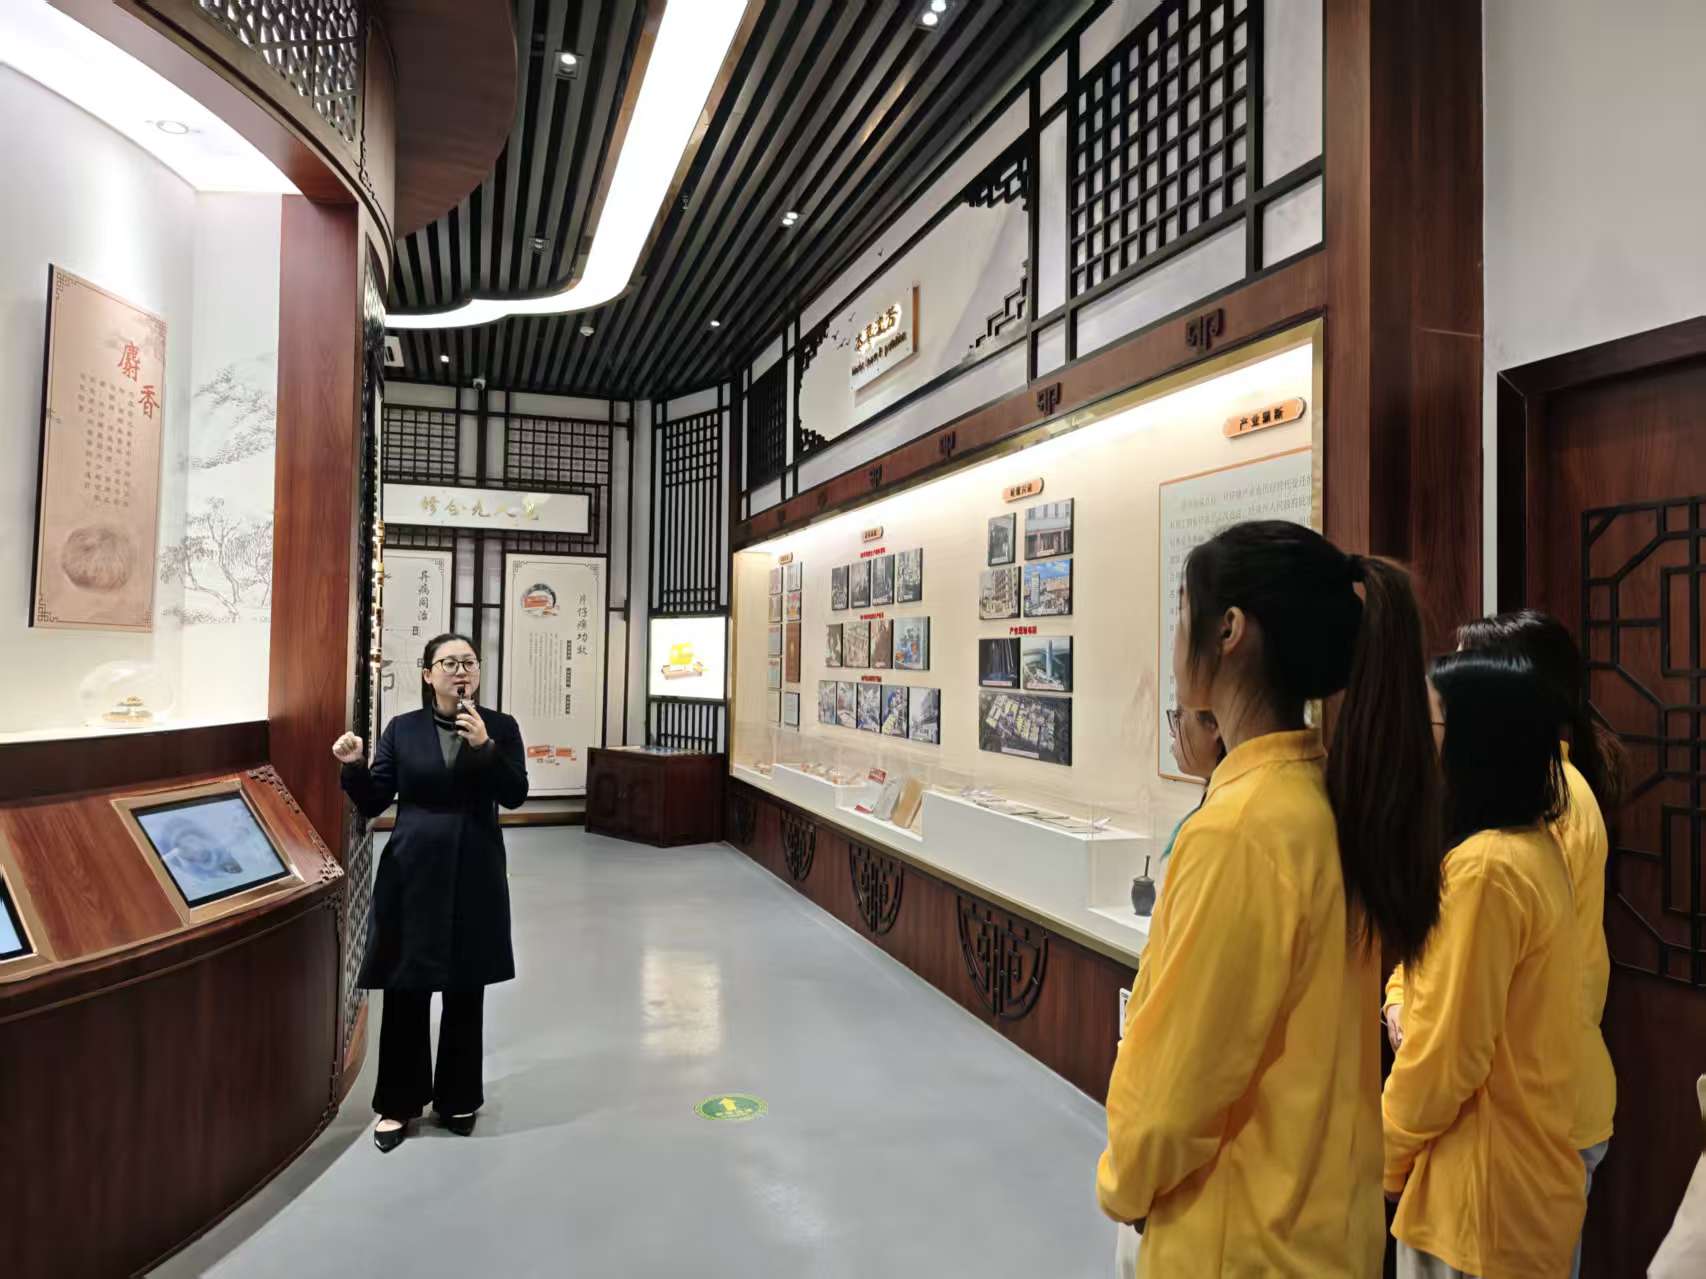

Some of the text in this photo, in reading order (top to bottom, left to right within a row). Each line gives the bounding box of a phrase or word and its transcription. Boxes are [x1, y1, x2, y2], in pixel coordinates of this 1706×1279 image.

[117, 340, 160, 420] 麝香
[417, 569, 431, 622] 异病同治
